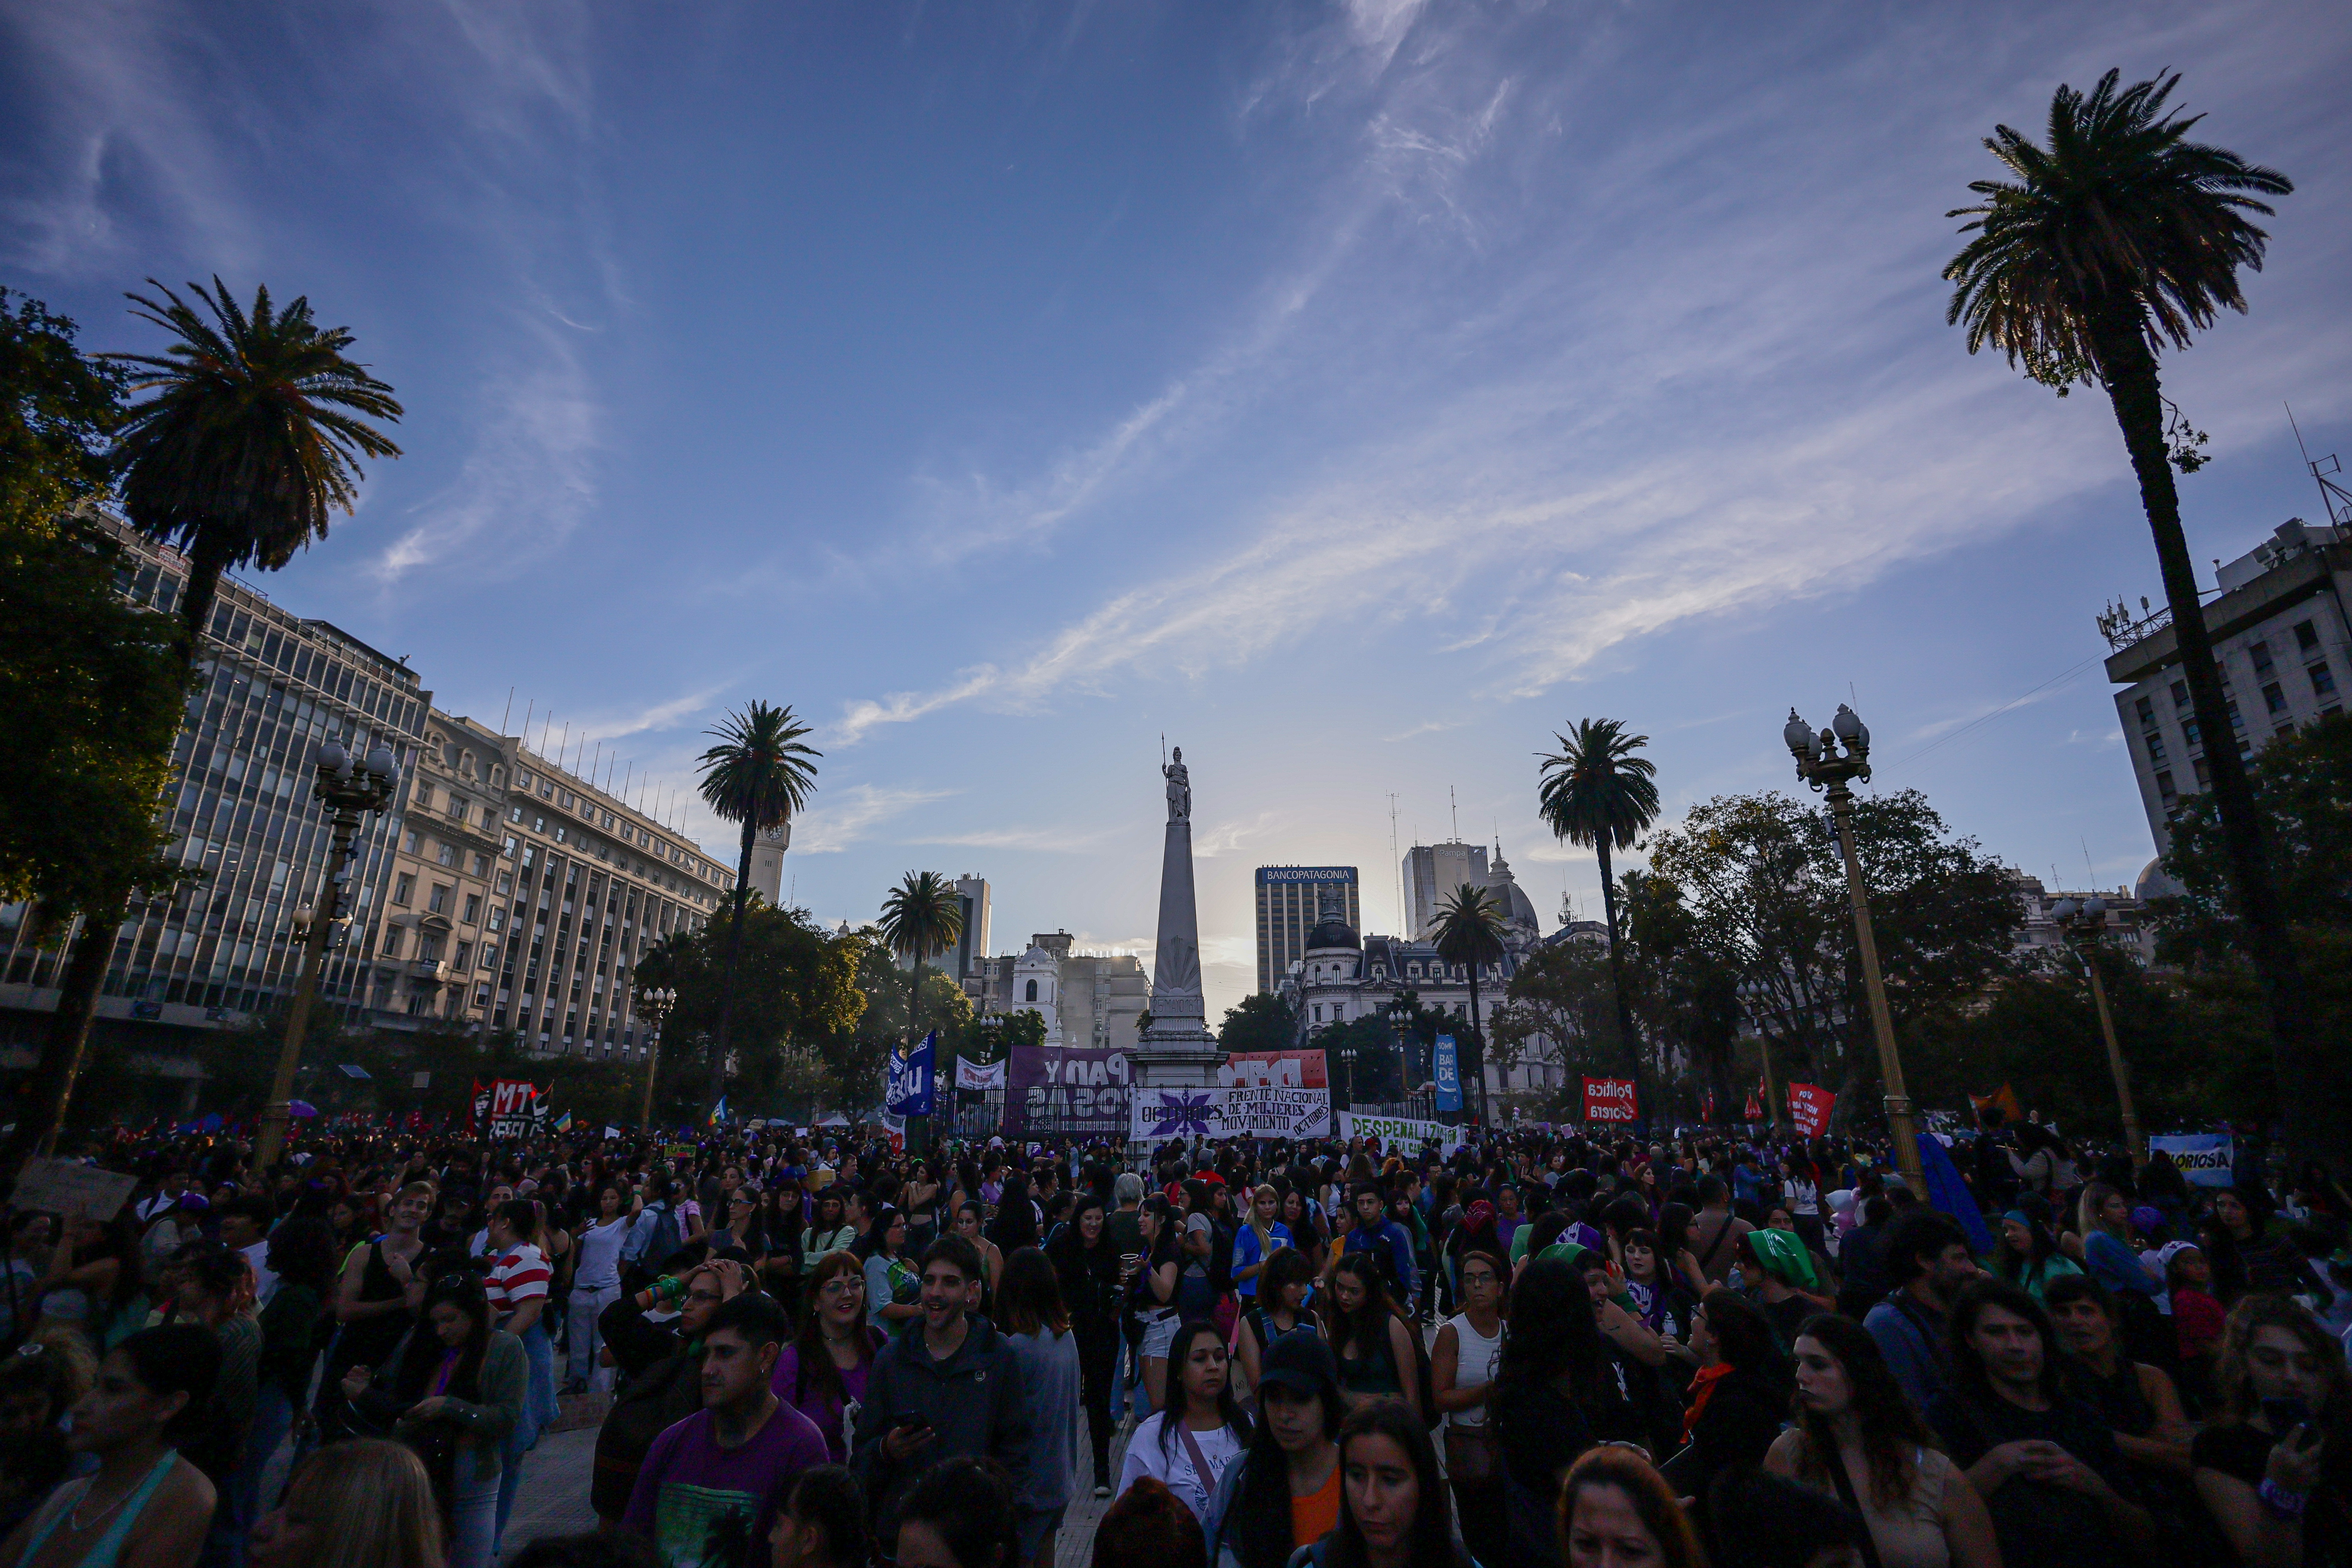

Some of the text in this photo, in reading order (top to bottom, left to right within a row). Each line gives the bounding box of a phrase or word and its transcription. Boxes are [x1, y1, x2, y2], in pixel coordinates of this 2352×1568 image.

[1165, 999, 1184, 1012] MAYO
[1439, 1067, 1454, 1081] DE
[1229, 1088, 1328, 1105] FRENTE NACIONAL
[1229, 1102, 1305, 1116] DE MUJERES
[1222, 1115, 1289, 1130] MOVIMIENTO
[1293, 1104, 1329, 1136] OCTUBRES
